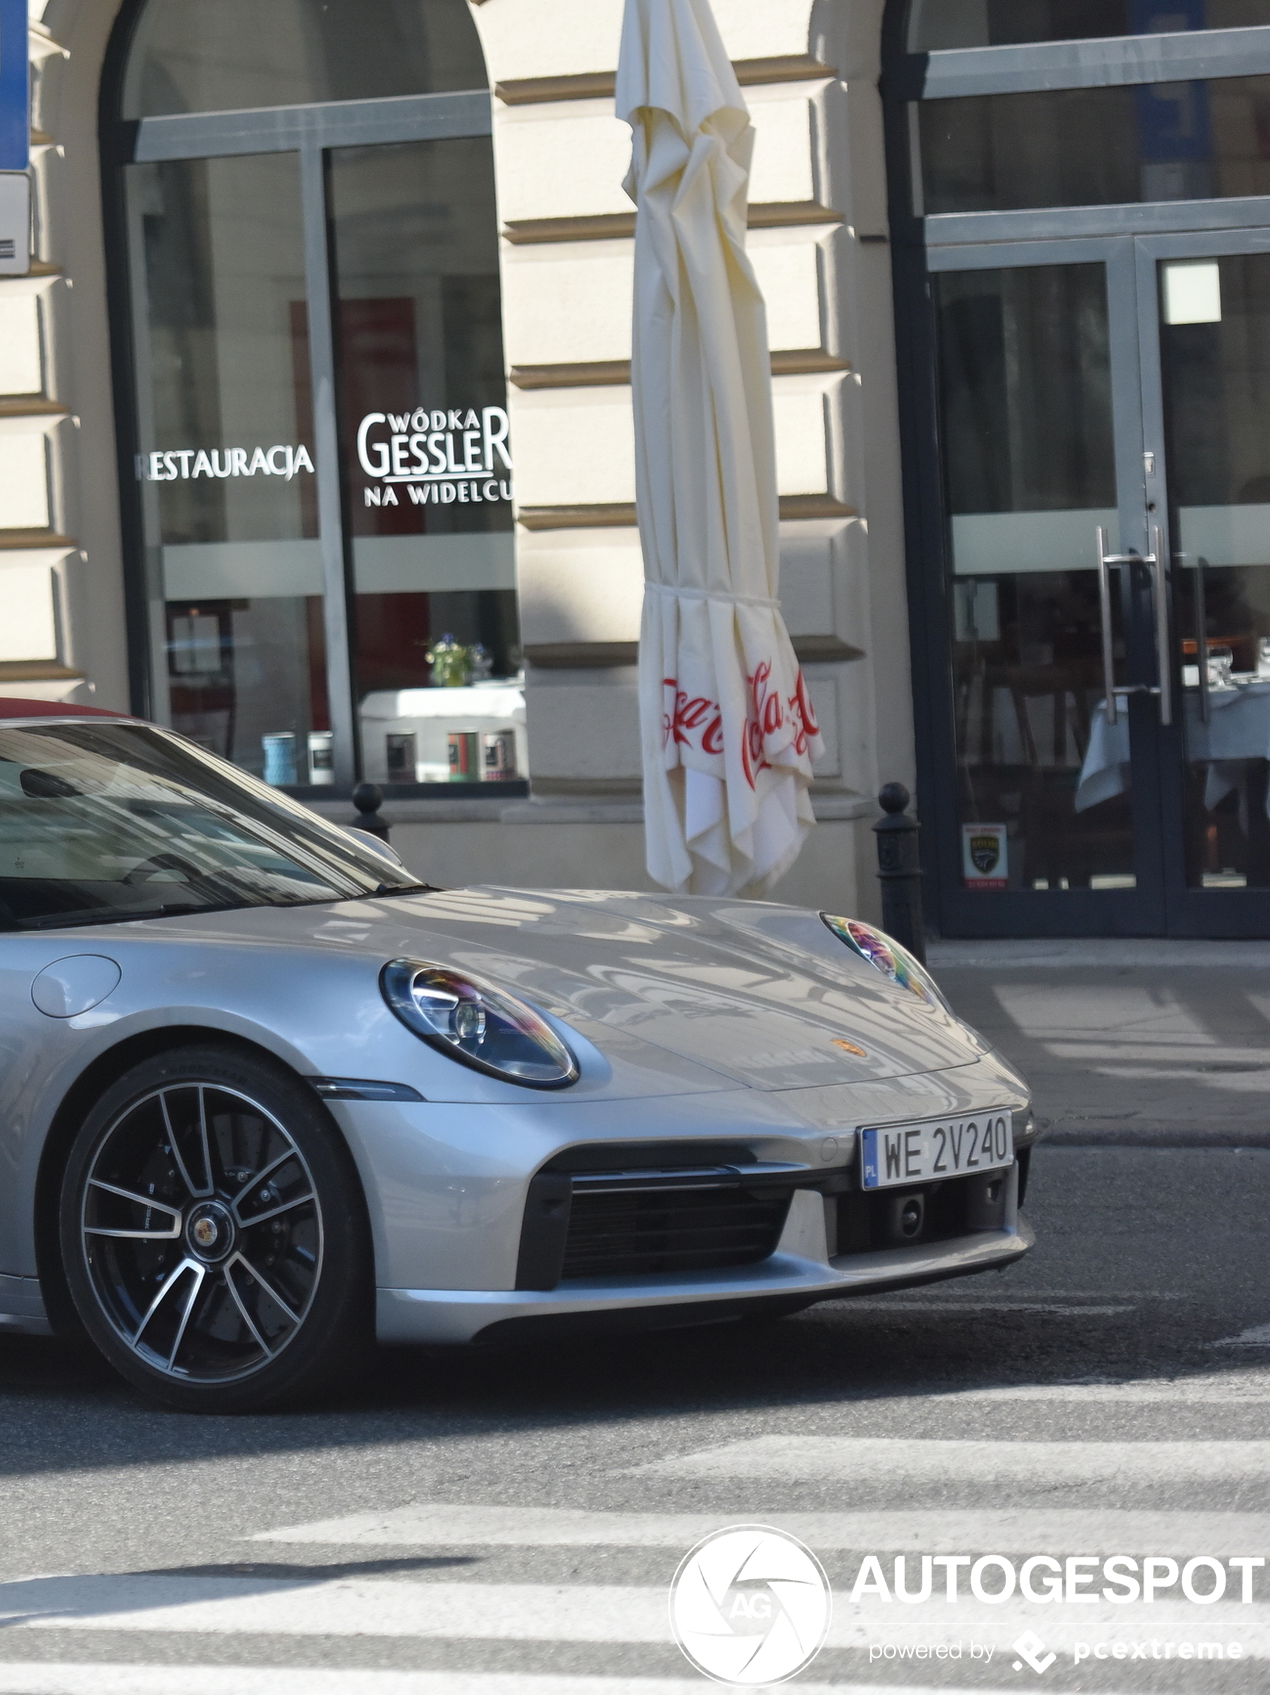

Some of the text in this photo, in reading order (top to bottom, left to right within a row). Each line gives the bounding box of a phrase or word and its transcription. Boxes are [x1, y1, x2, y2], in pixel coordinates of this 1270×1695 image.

[386, 407, 481, 433] WÓDKA
[357, 406, 515, 478] GESSLER
[363, 479, 515, 507] NA WIDELCU
[885, 1116, 1007, 1180] WE 2V240
[865, 1165, 877, 1179] PL
